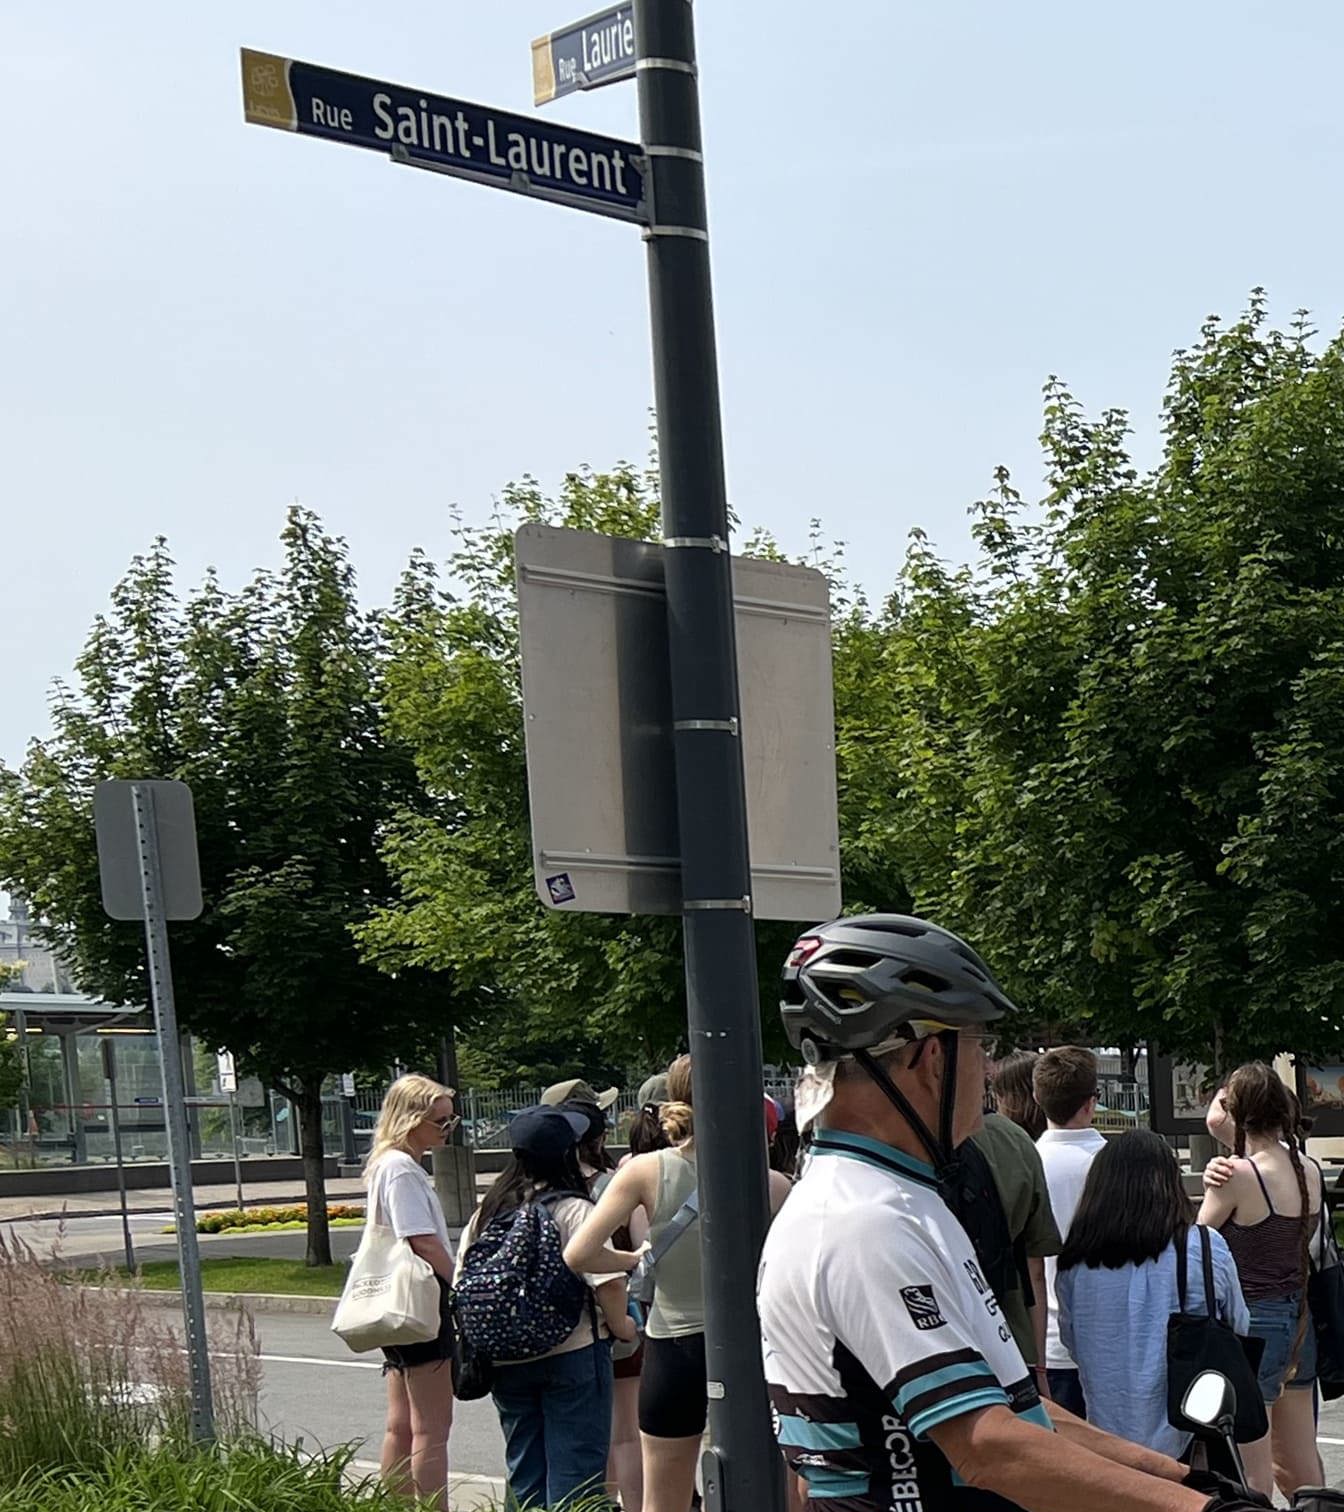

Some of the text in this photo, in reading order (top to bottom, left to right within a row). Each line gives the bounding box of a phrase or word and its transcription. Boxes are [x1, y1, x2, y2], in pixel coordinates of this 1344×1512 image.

[559, 57, 577, 83] Rue
[311, 92, 627, 195] Rue Saint-Laurent
